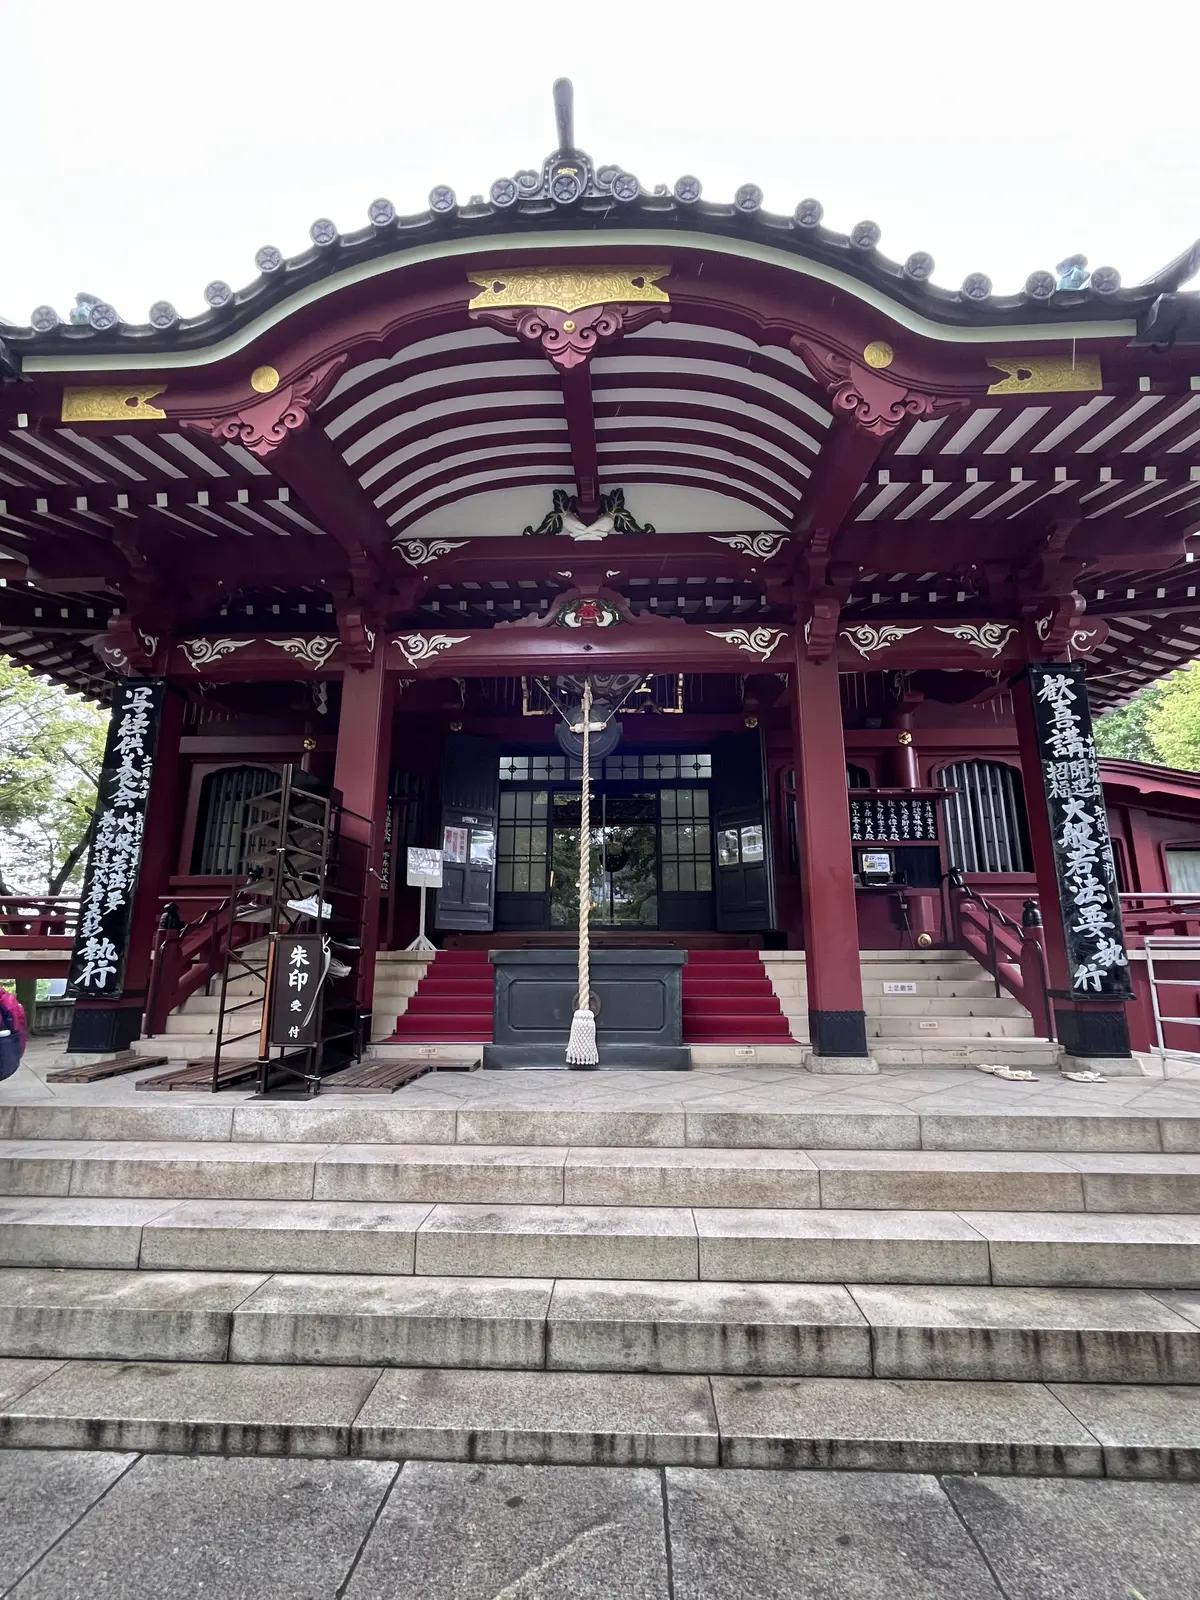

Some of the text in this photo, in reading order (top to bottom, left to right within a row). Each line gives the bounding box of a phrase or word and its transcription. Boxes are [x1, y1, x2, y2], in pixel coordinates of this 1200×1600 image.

[108, 686, 154, 808] 写経供養会
[1036, 674, 1088, 758] 歓喜講
[1046, 760, 1072, 800] 招福
[74, 936, 119, 989] 執行
